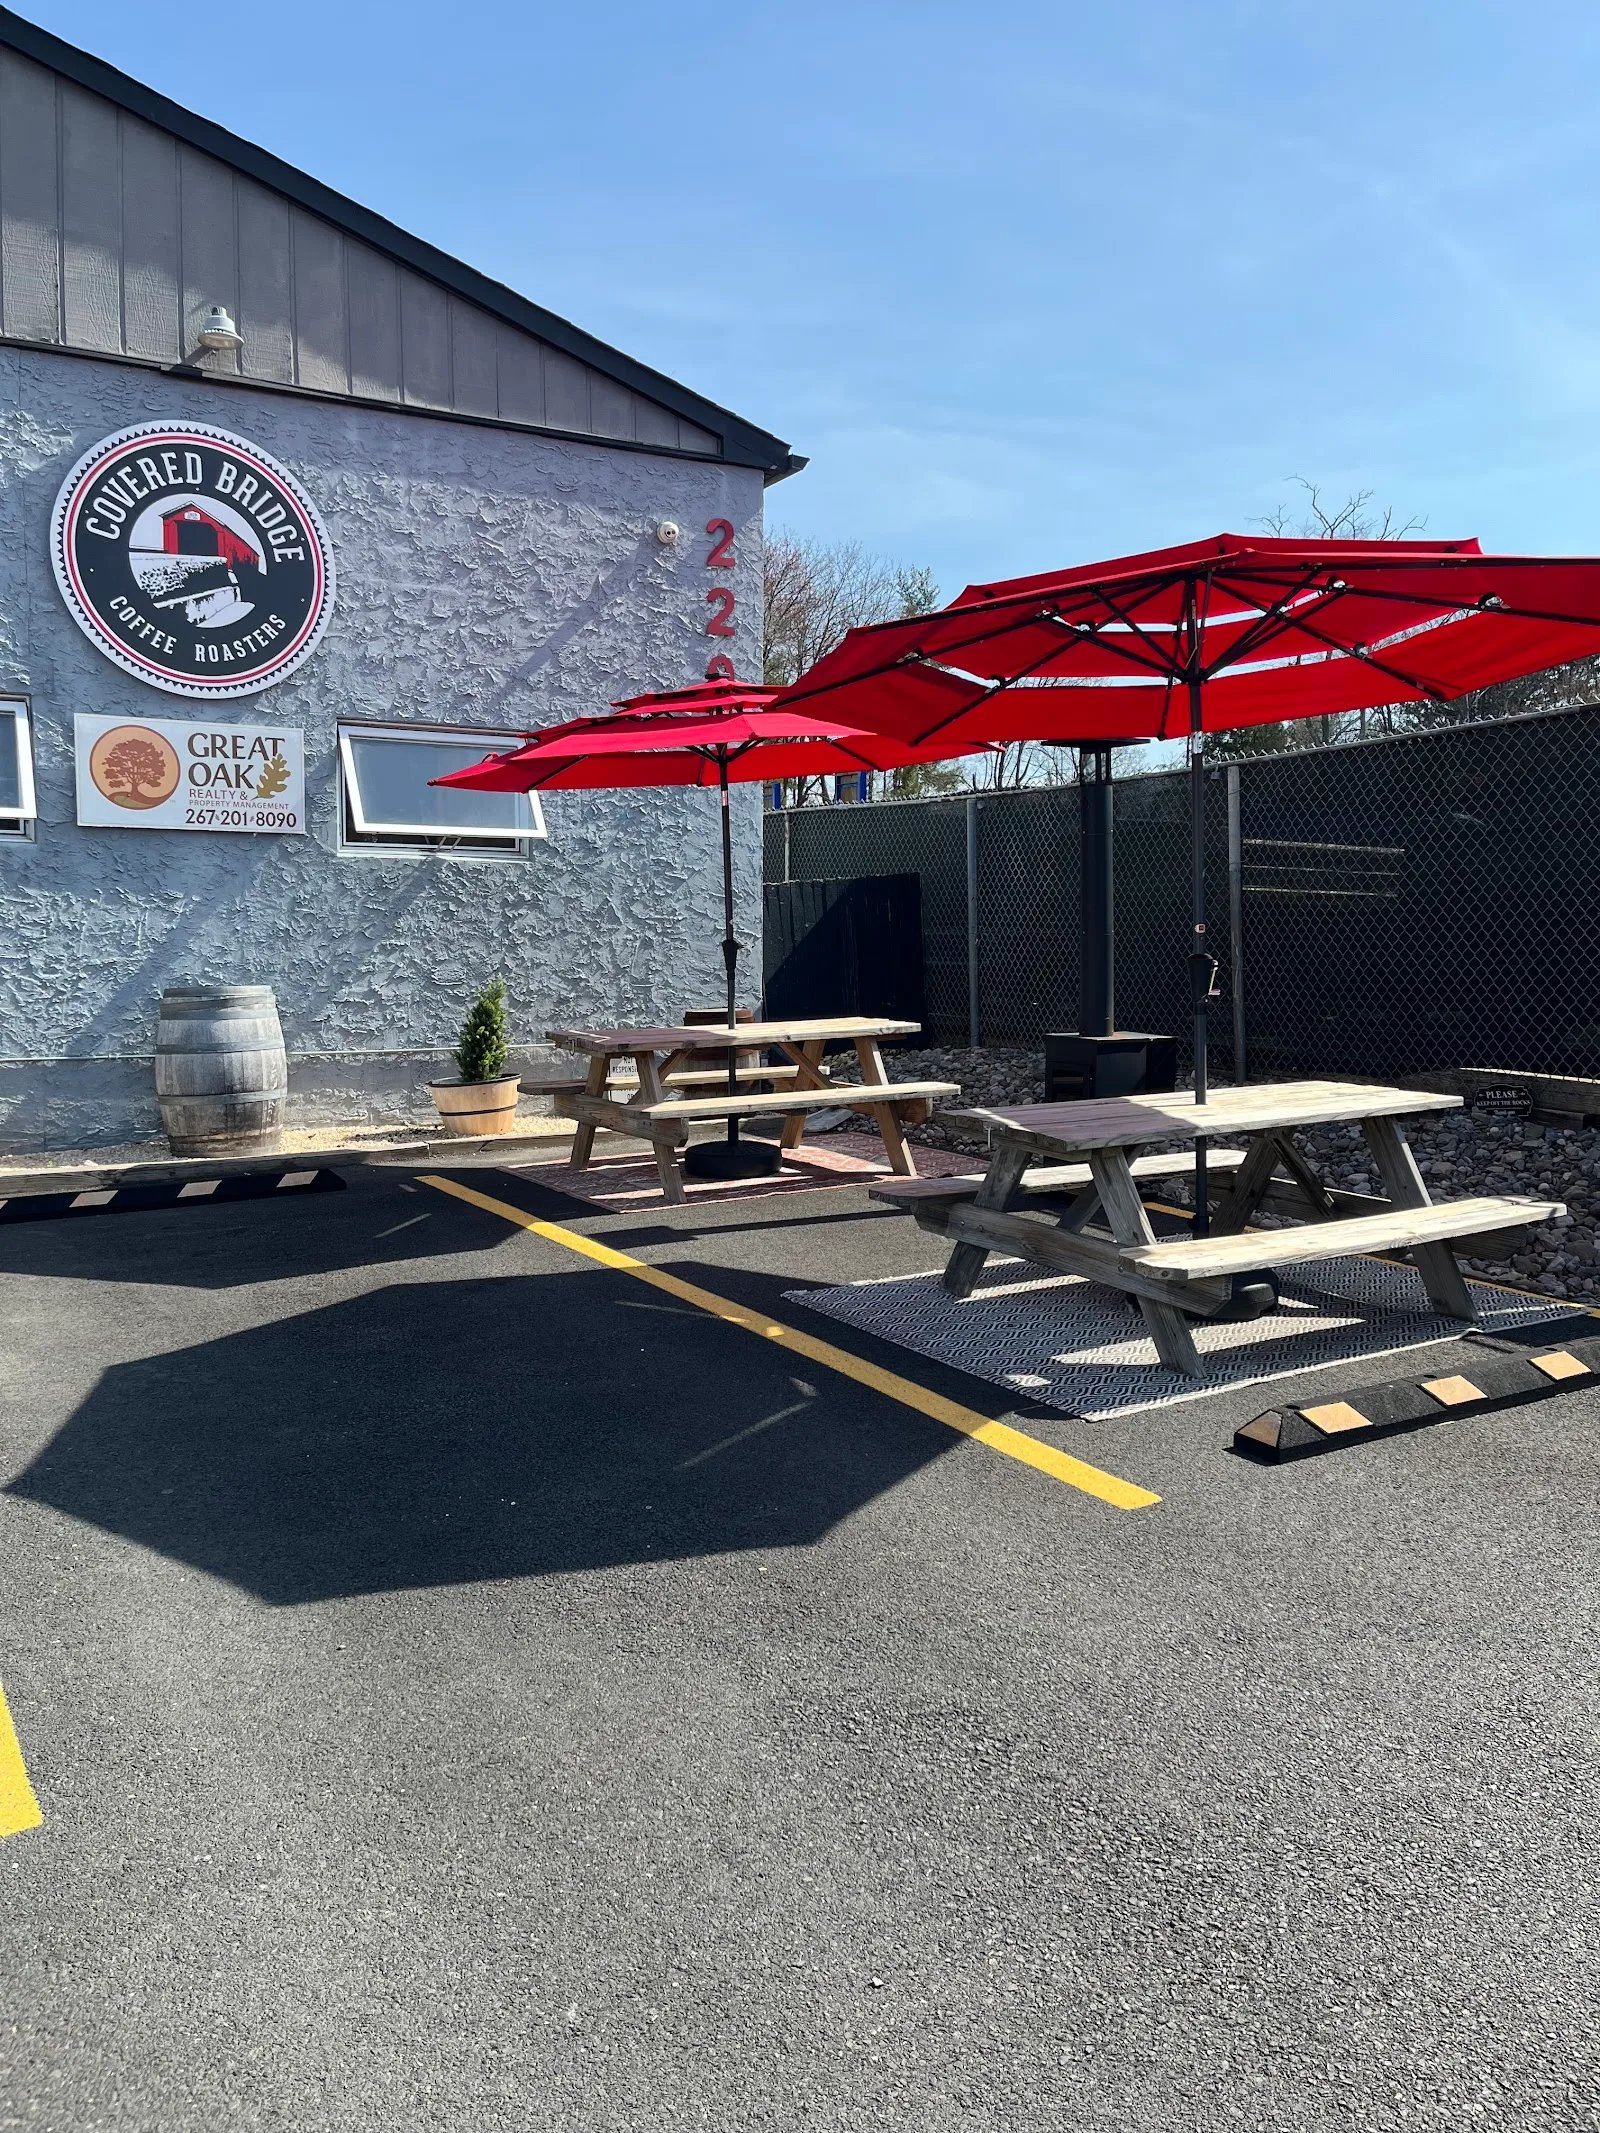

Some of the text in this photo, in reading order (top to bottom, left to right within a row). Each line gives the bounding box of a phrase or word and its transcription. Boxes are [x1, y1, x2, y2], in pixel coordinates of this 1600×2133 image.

[86, 452, 305, 563] COVERED BRIDGE
[109, 595, 286, 663] COFFEE ROASTERS
[187, 732, 286, 761] GREAT
[188, 762, 256, 789] OAK
[189, 788, 248, 801] REALTY &
[189, 799, 290, 810] PROPERTY MANAGEMENT
[1486, 1090, 1518, 1099] PLEASE
